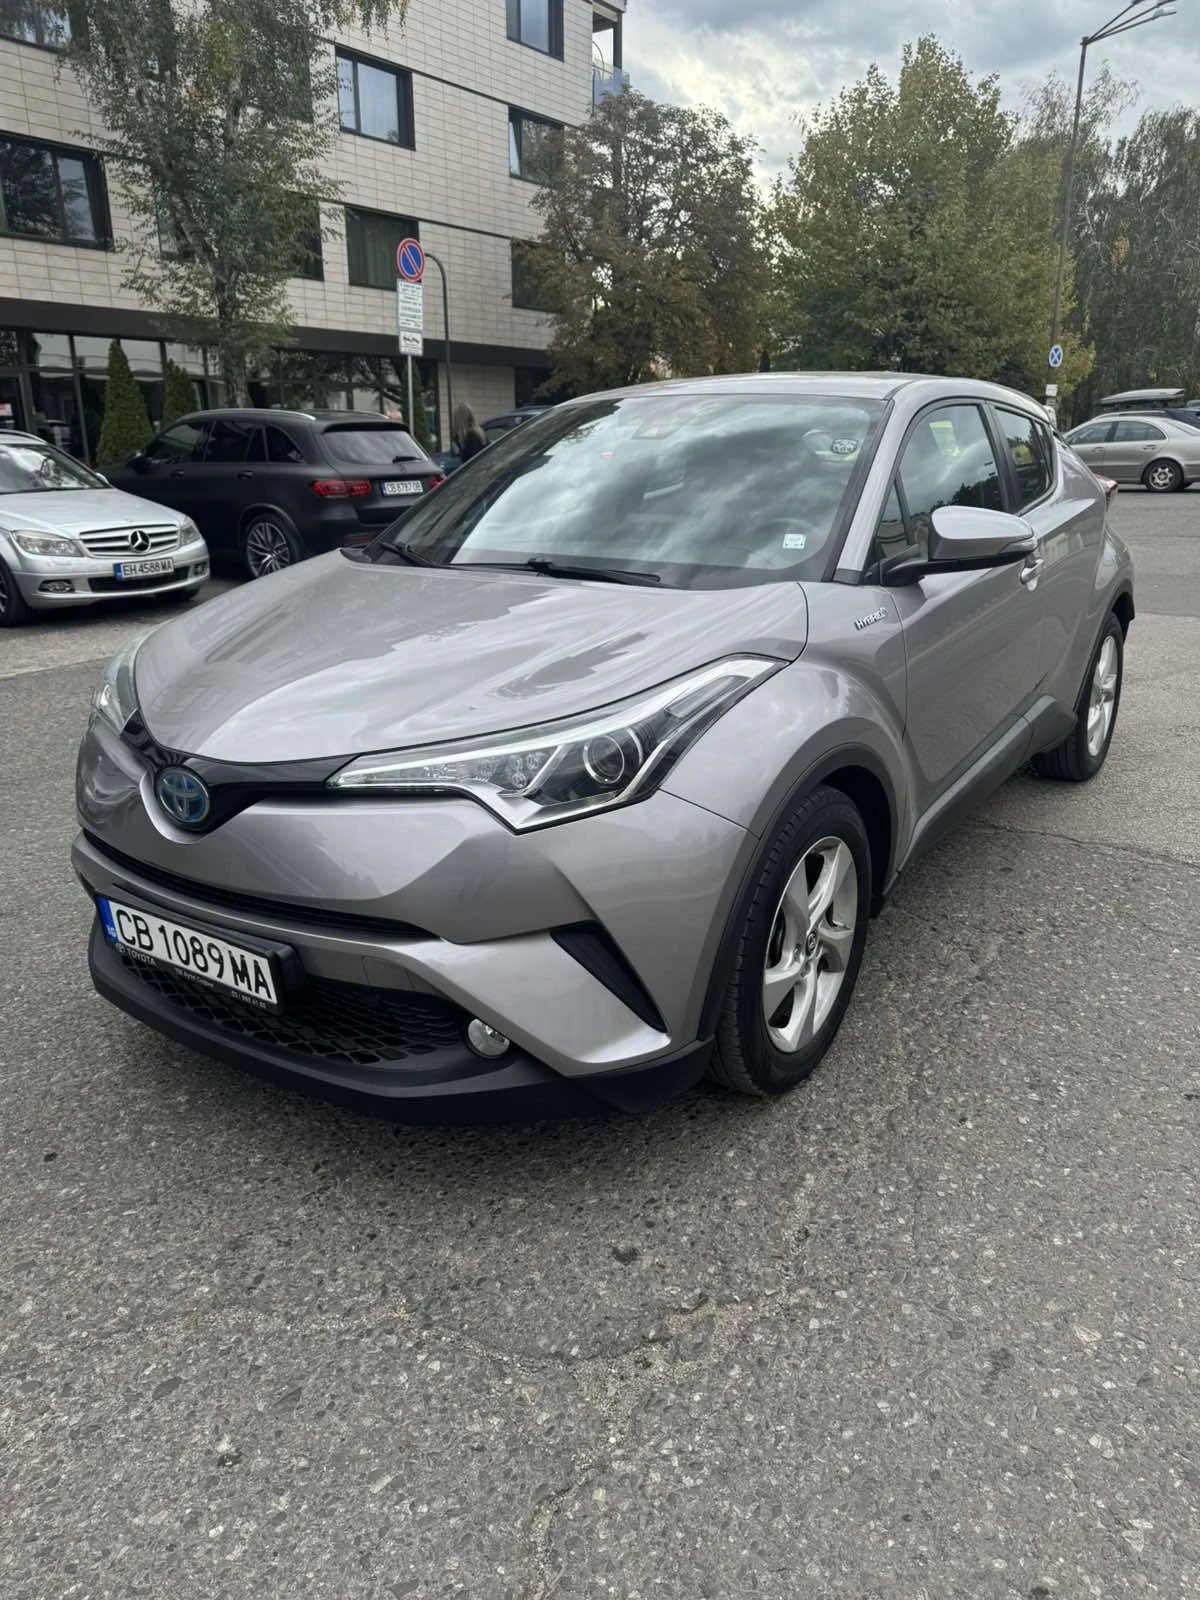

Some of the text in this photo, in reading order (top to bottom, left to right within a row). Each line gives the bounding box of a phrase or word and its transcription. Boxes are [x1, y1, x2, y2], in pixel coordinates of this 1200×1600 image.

[123, 564, 137, 576] EH
[116, 909, 154, 951] CB
[158, 924, 225, 979] 1089
[228, 950, 272, 1000] MA
[127, 946, 158, 968] TOYOTA
